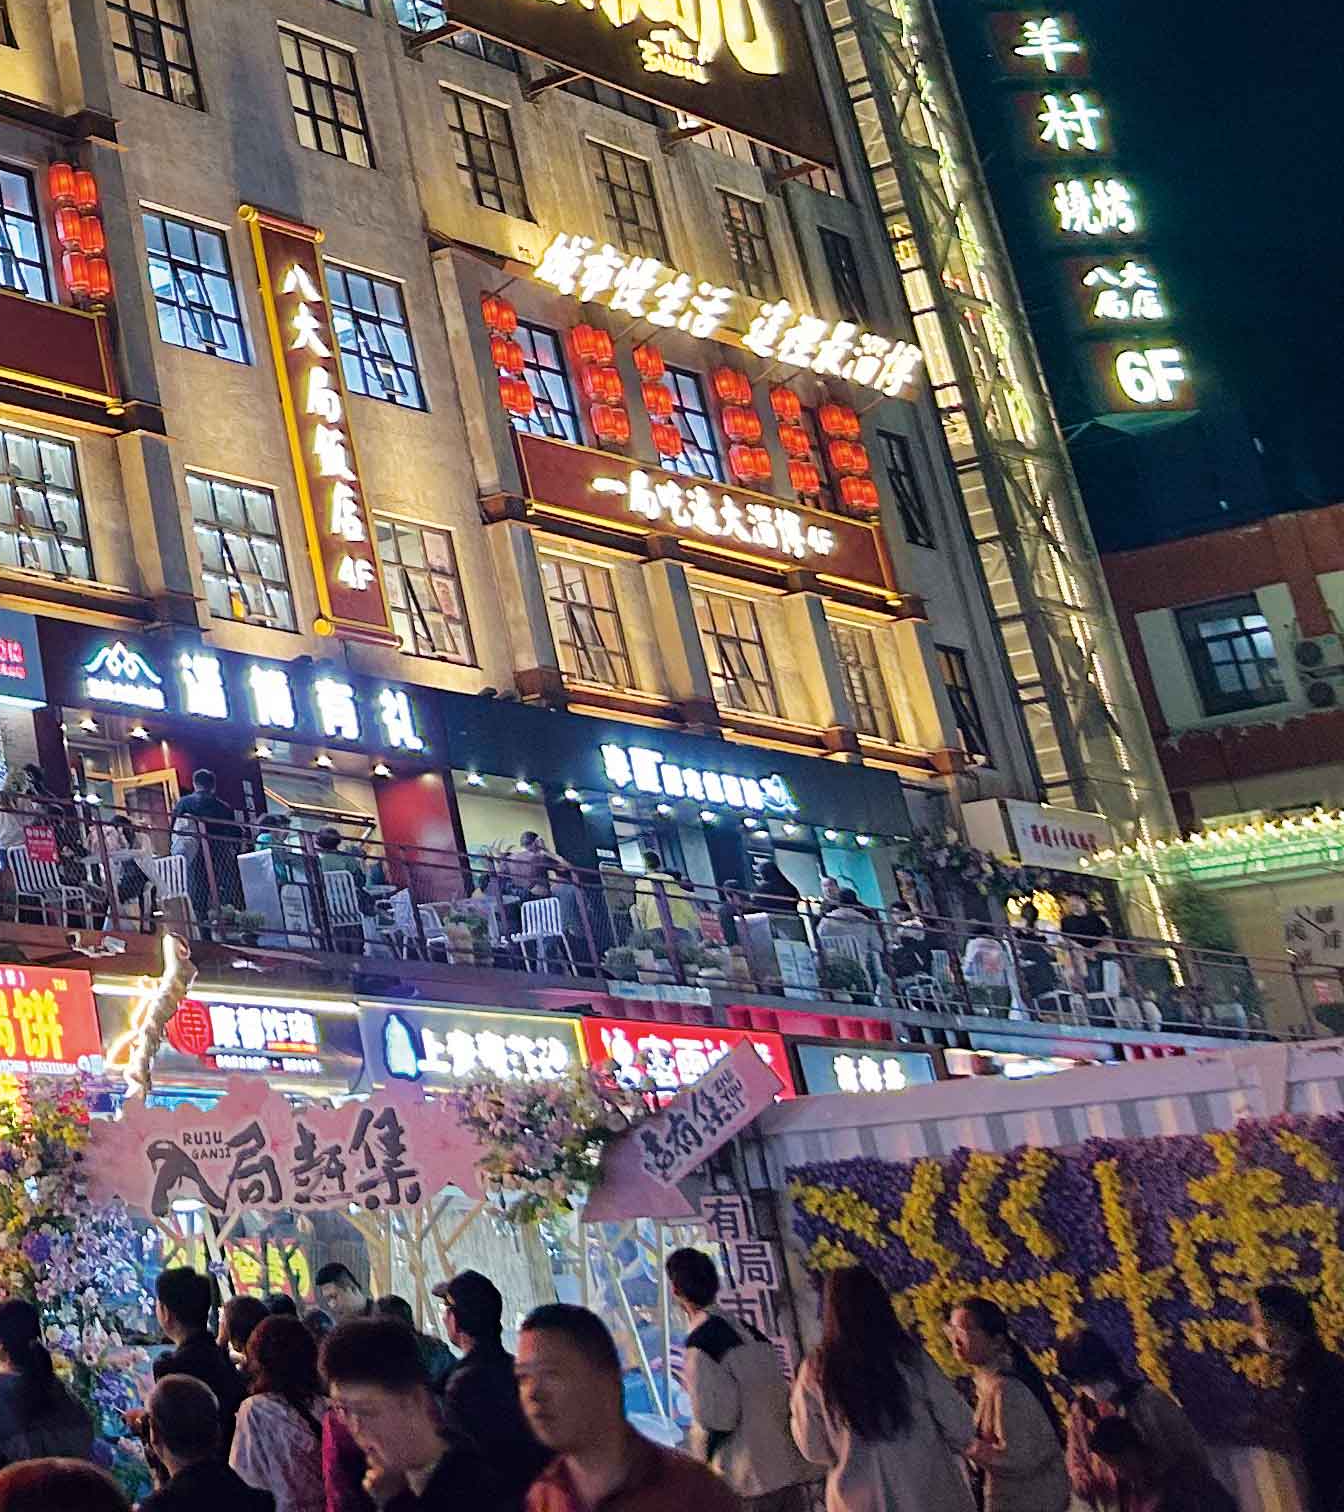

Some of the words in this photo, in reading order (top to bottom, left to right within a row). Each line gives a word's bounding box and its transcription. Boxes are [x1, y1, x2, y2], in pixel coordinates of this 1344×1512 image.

[1116, 348, 1186, 405] 6F
[182, 1131, 223, 1146] RUJU
[191, 1147, 232, 1161] GANJI
